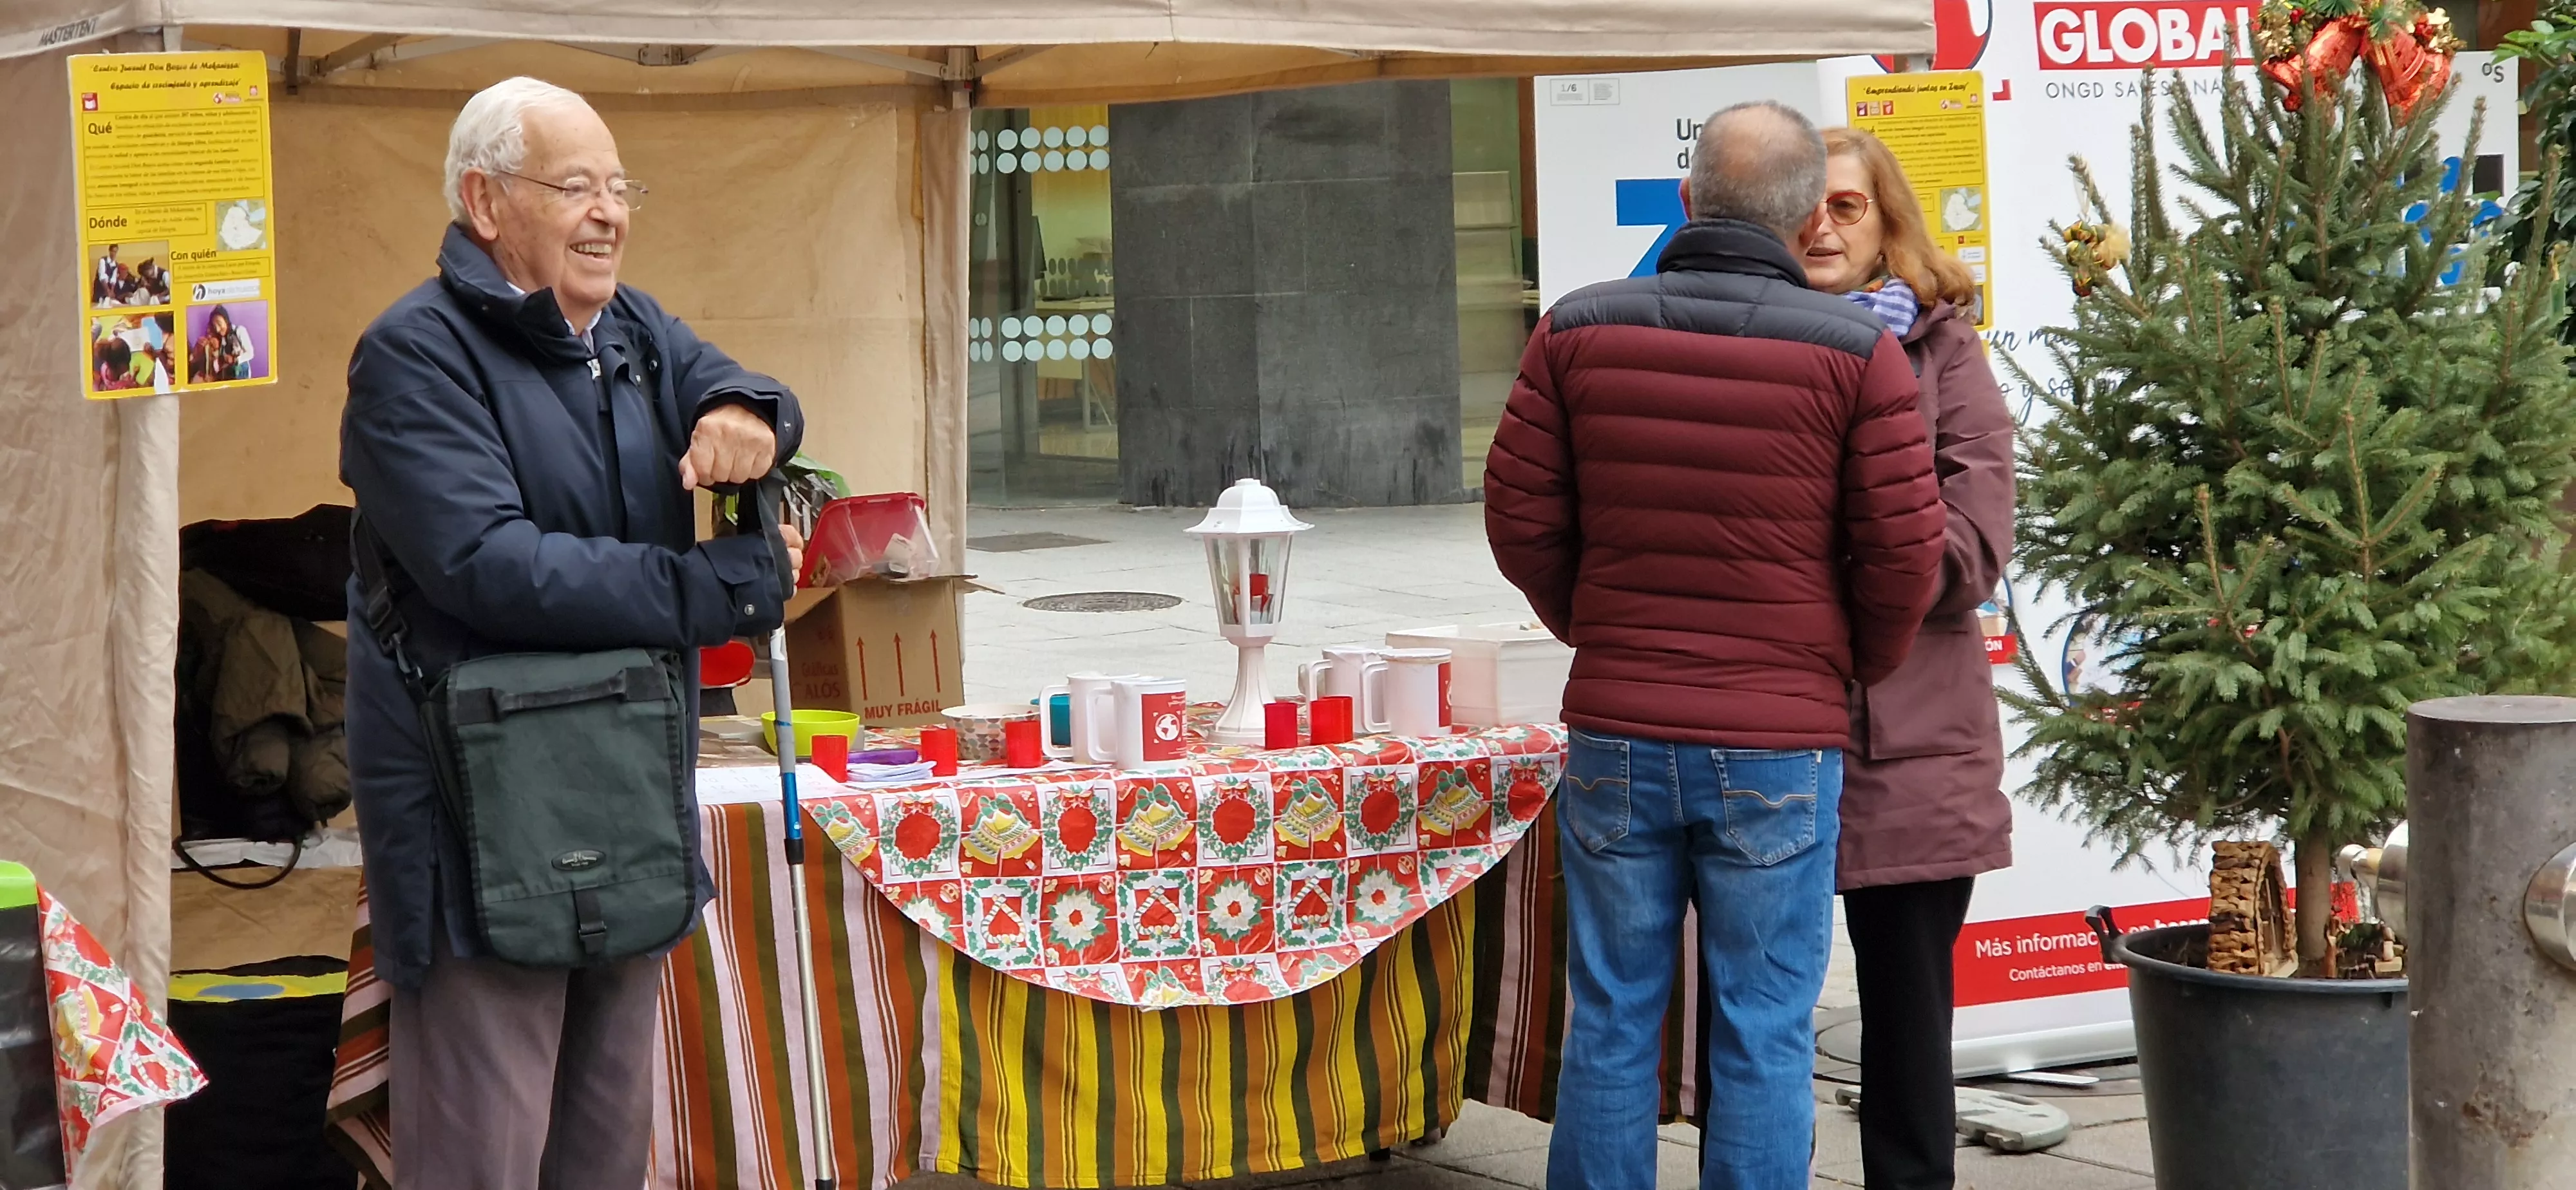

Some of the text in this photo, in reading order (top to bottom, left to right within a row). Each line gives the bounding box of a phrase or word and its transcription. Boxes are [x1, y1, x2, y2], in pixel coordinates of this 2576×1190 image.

[38, 16, 99, 46] MASTERTENT
[2040, 7, 2255, 64] GLOBAL
[2045, 82, 2105, 99] ONGD
[88, 121, 112, 135] Qué
[89, 214, 128, 229] Dónde
[171, 248, 217, 261] Con quién
[864, 698, 942, 720] MUY FRÁGIL
[1975, 937, 2012, 959] Más
[2017, 931, 2101, 954] informac
[2009, 964, 2085, 982] Contáctanos
[2087, 961, 2102, 973] en
